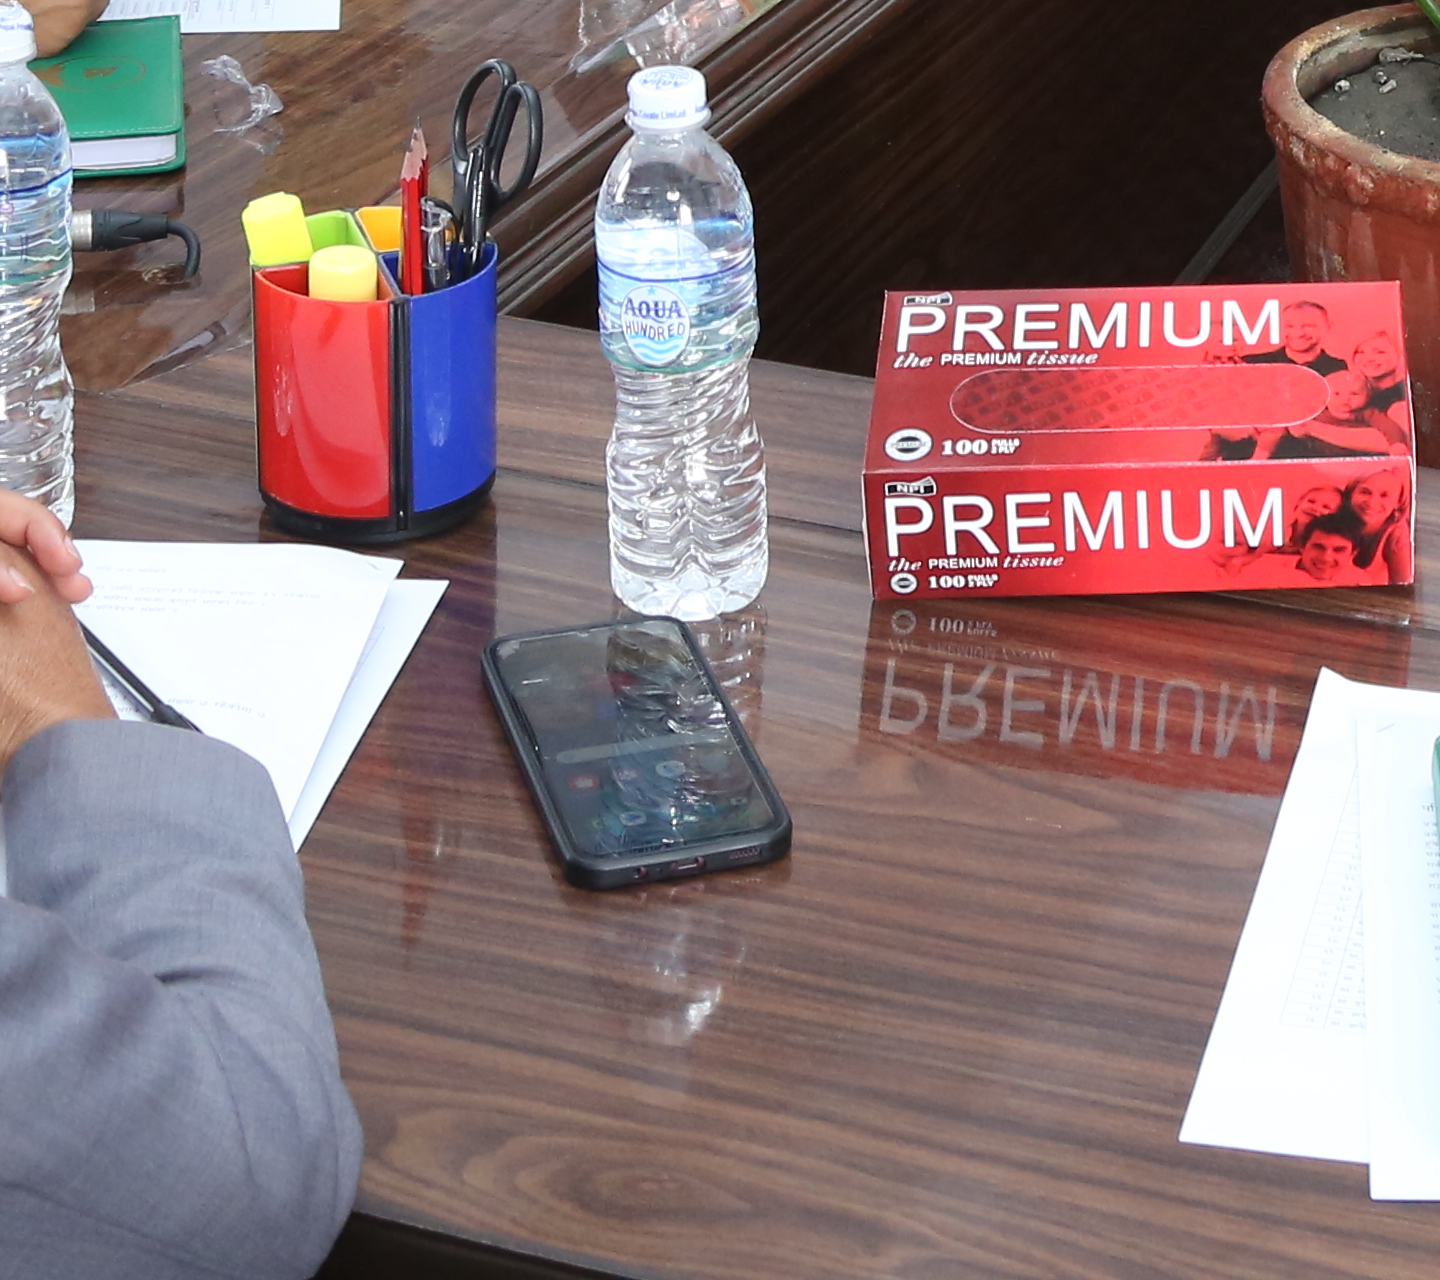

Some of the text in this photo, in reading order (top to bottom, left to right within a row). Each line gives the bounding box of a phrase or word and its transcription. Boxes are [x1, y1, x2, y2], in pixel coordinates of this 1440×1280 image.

[624, 297, 685, 324] AQUA
[624, 319, 686, 341] HUNDRED
[895, 299, 1281, 353] PREMIUM
[893, 350, 1099, 368] the PREMIUM tissue
[941, 439, 989, 456] 100
[991, 438, 1021, 447] PULLS
[999, 445, 1016, 454] PLY
[884, 487, 1284, 558] PREMIUM
[888, 554, 1064, 572] the PREMIUM tissue
[928, 574, 966, 589] 100
